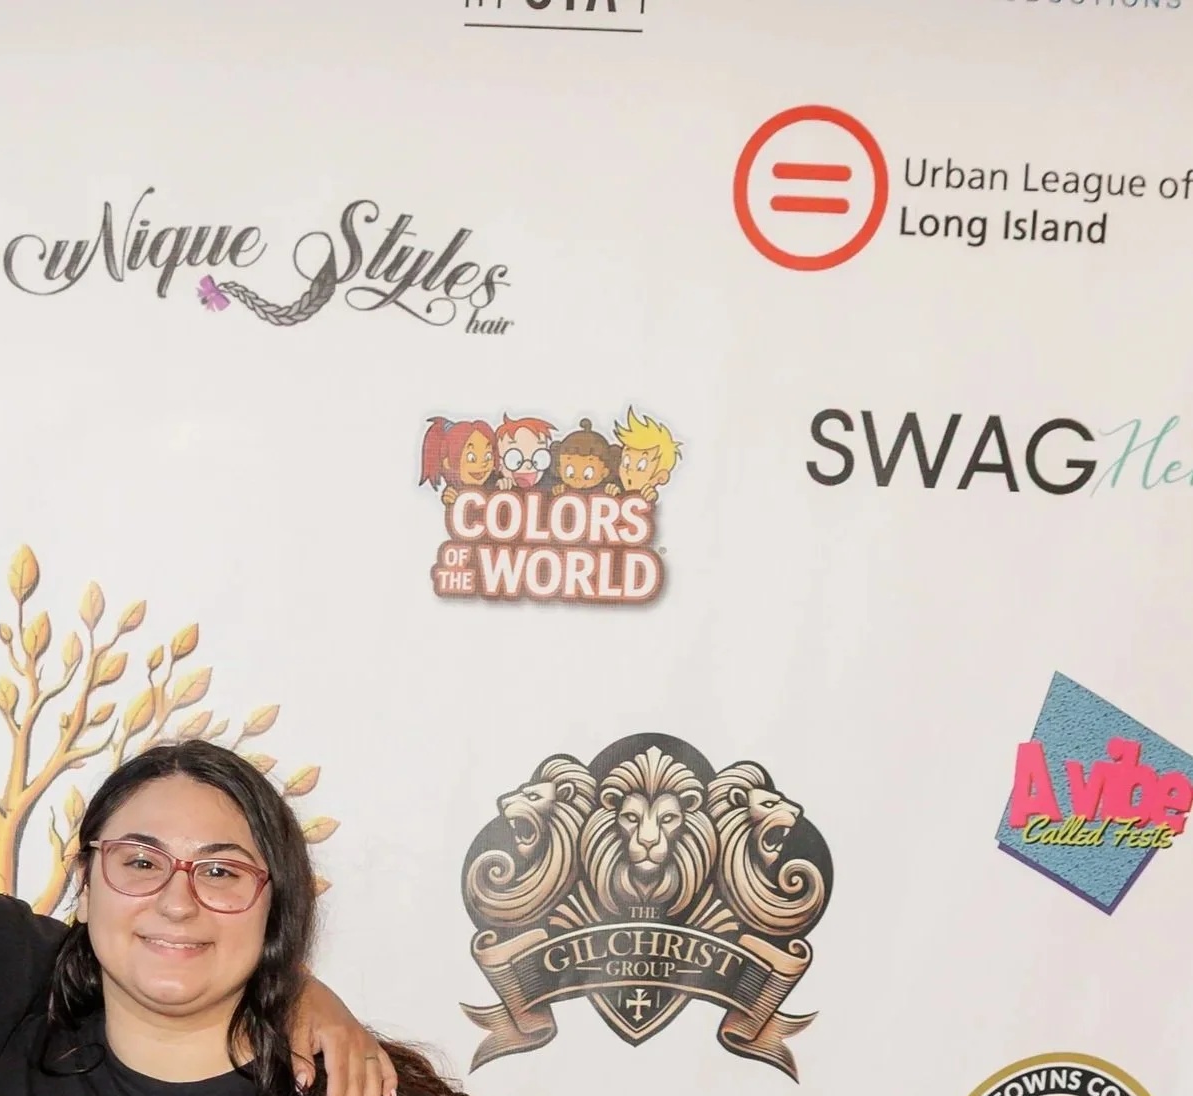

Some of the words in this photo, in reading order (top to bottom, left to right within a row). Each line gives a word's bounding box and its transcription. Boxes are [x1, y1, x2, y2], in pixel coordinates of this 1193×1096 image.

[904, 157, 1008, 191] Urban
[1023, 162, 1147, 203] League
[1159, 169, 1193, 200] of
[899, 206, 988, 247] Long
[1003, 210, 1108, 244] Island
[293, 199, 511, 326] Styles
[465, 308, 516, 336] hair
[805, 408, 1098, 496] SWAG
[1090, 415, 1193, 498] He
[452, 492, 651, 543] COLORS
[444, 548, 468, 568] OF
[479, 548, 657, 598] WORLD
[438, 571, 474, 591] THE
[1010, 739, 1063, 828] A
[1023, 815, 1110, 847] Called
[1114, 816, 1177, 849] Fests
[628, 906, 660, 919] THE
[543, 930, 743, 977] GILCHRIST
[606, 960, 675, 977] GROUP
